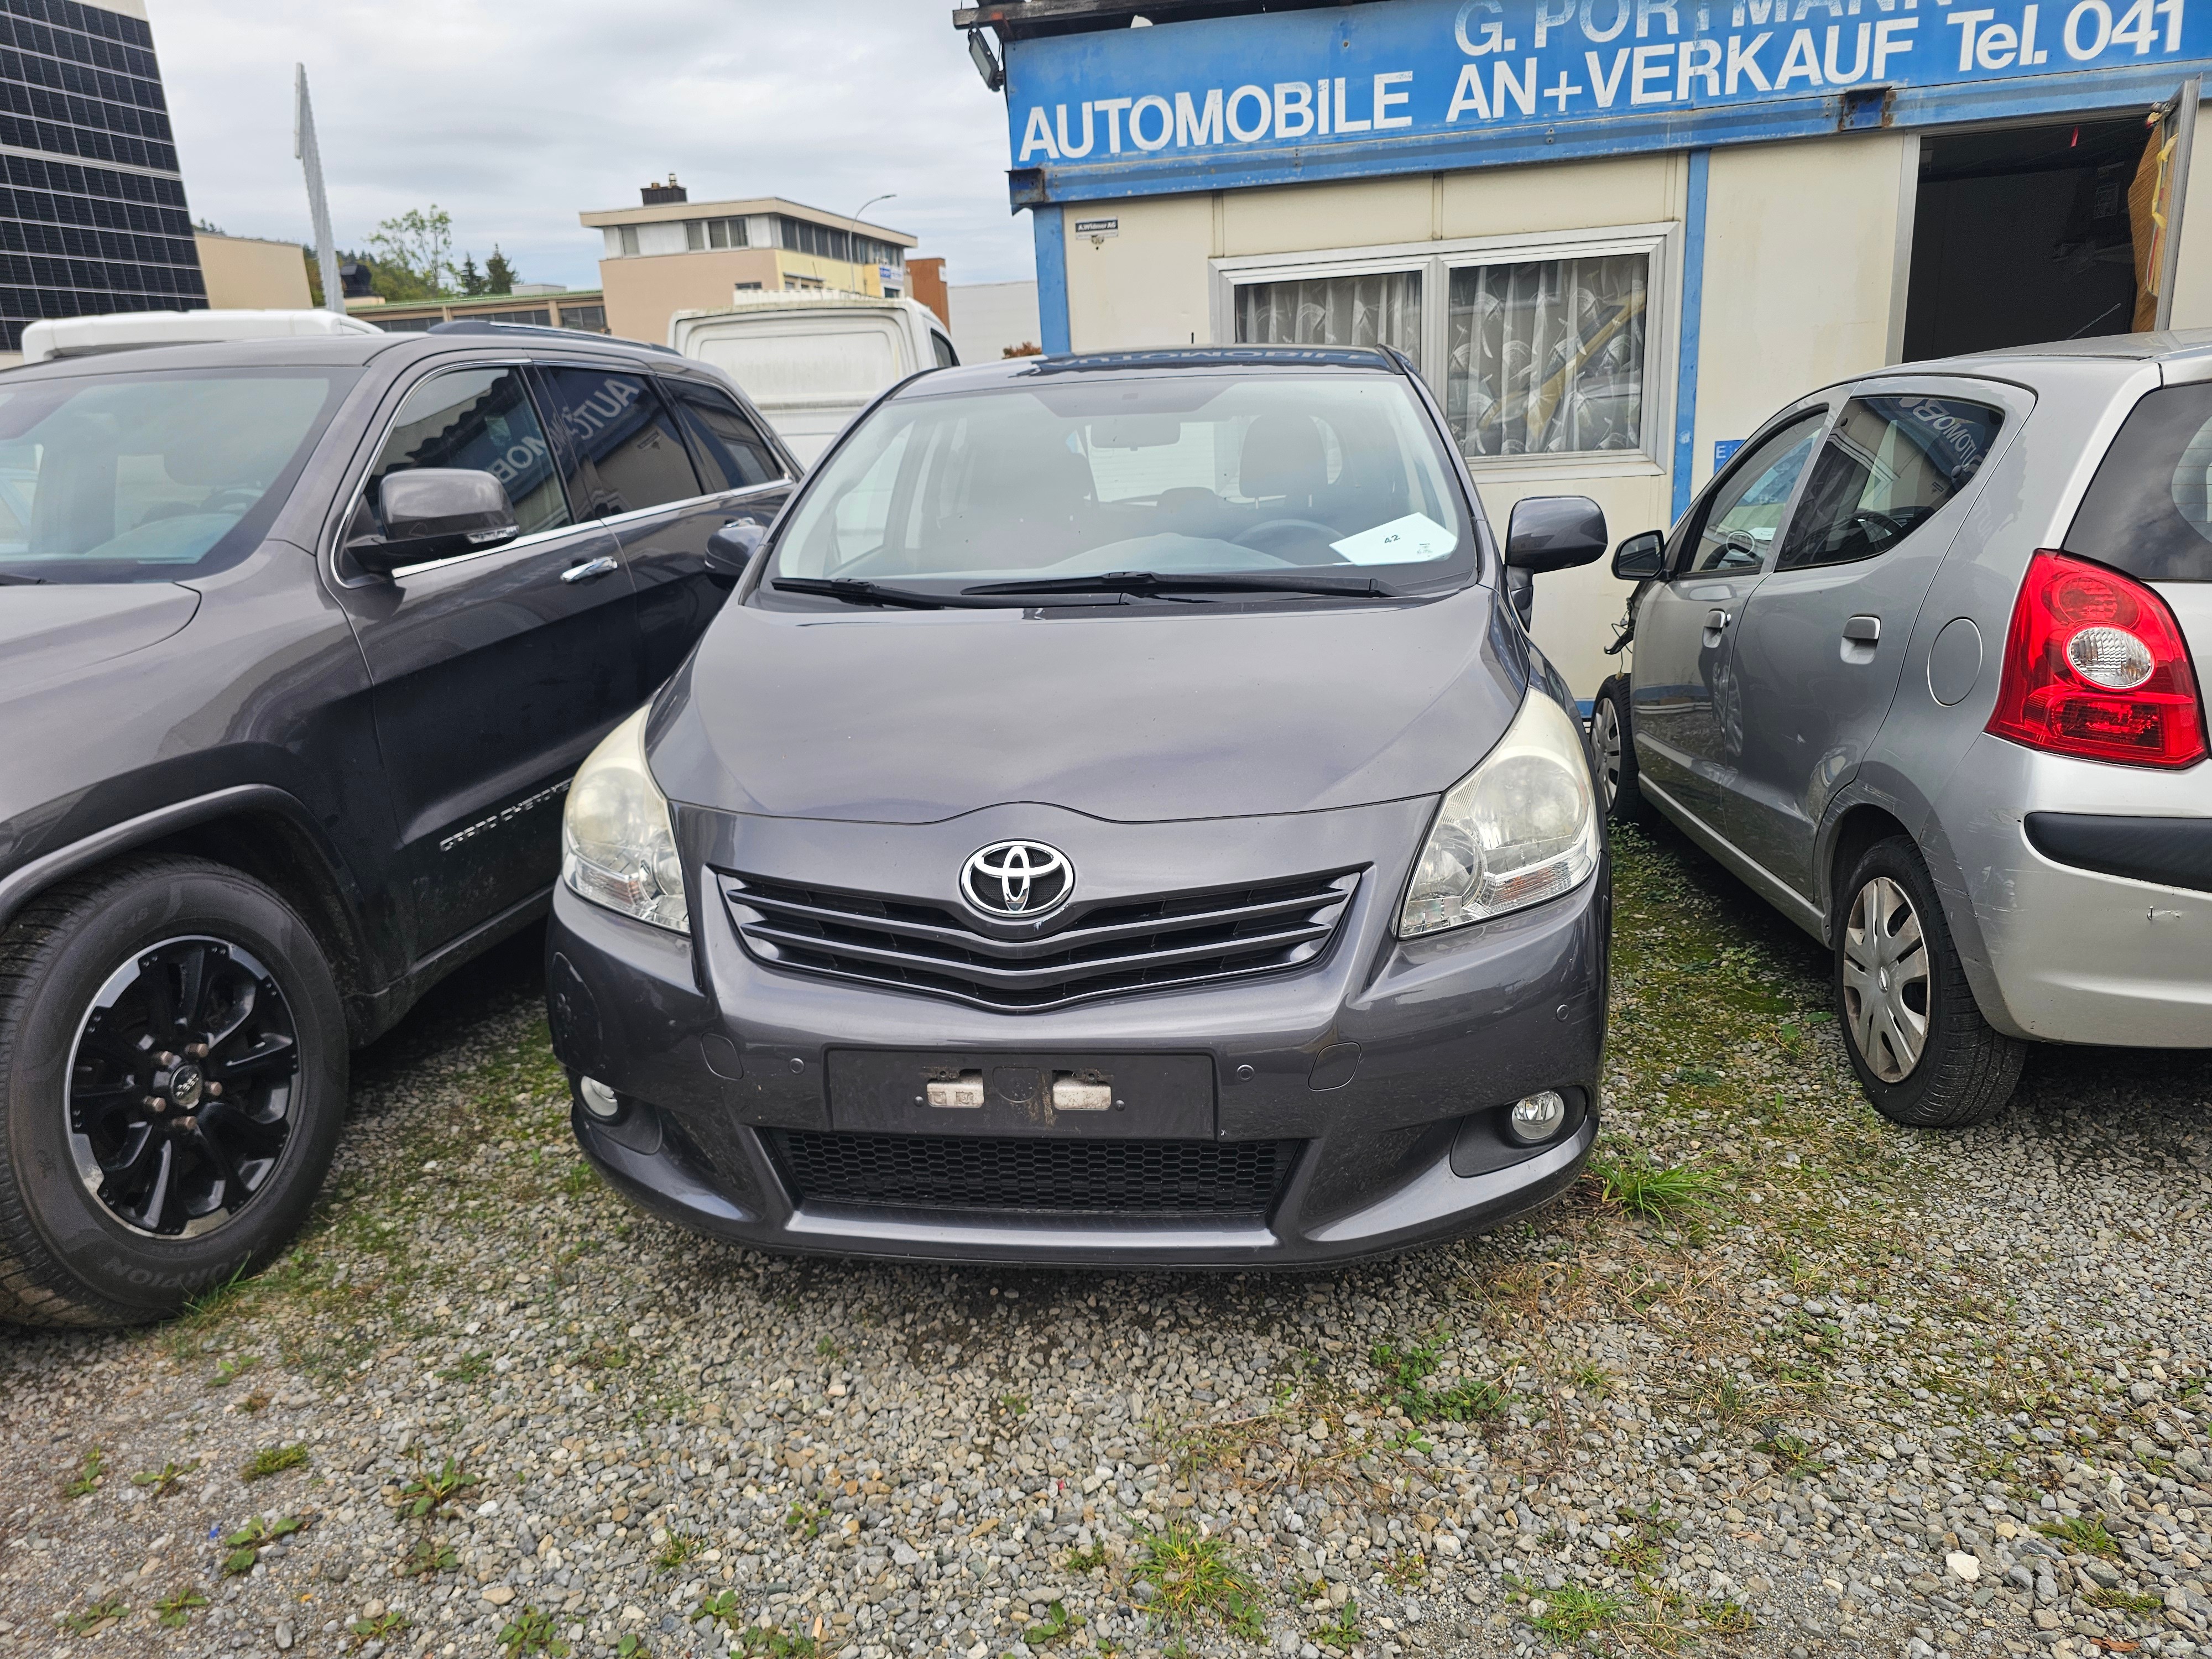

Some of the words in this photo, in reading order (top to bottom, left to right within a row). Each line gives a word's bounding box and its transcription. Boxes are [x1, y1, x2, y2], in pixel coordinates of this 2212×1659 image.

[1019, 70, 1413, 161] AUTOMOBILE
[1446, 17, 1919, 123] AN+VERKAUF
[1947, 4, 2048, 71] Tel.
[2064, 0, 2184, 60] 041
[1455, 0, 1516, 56] G.
